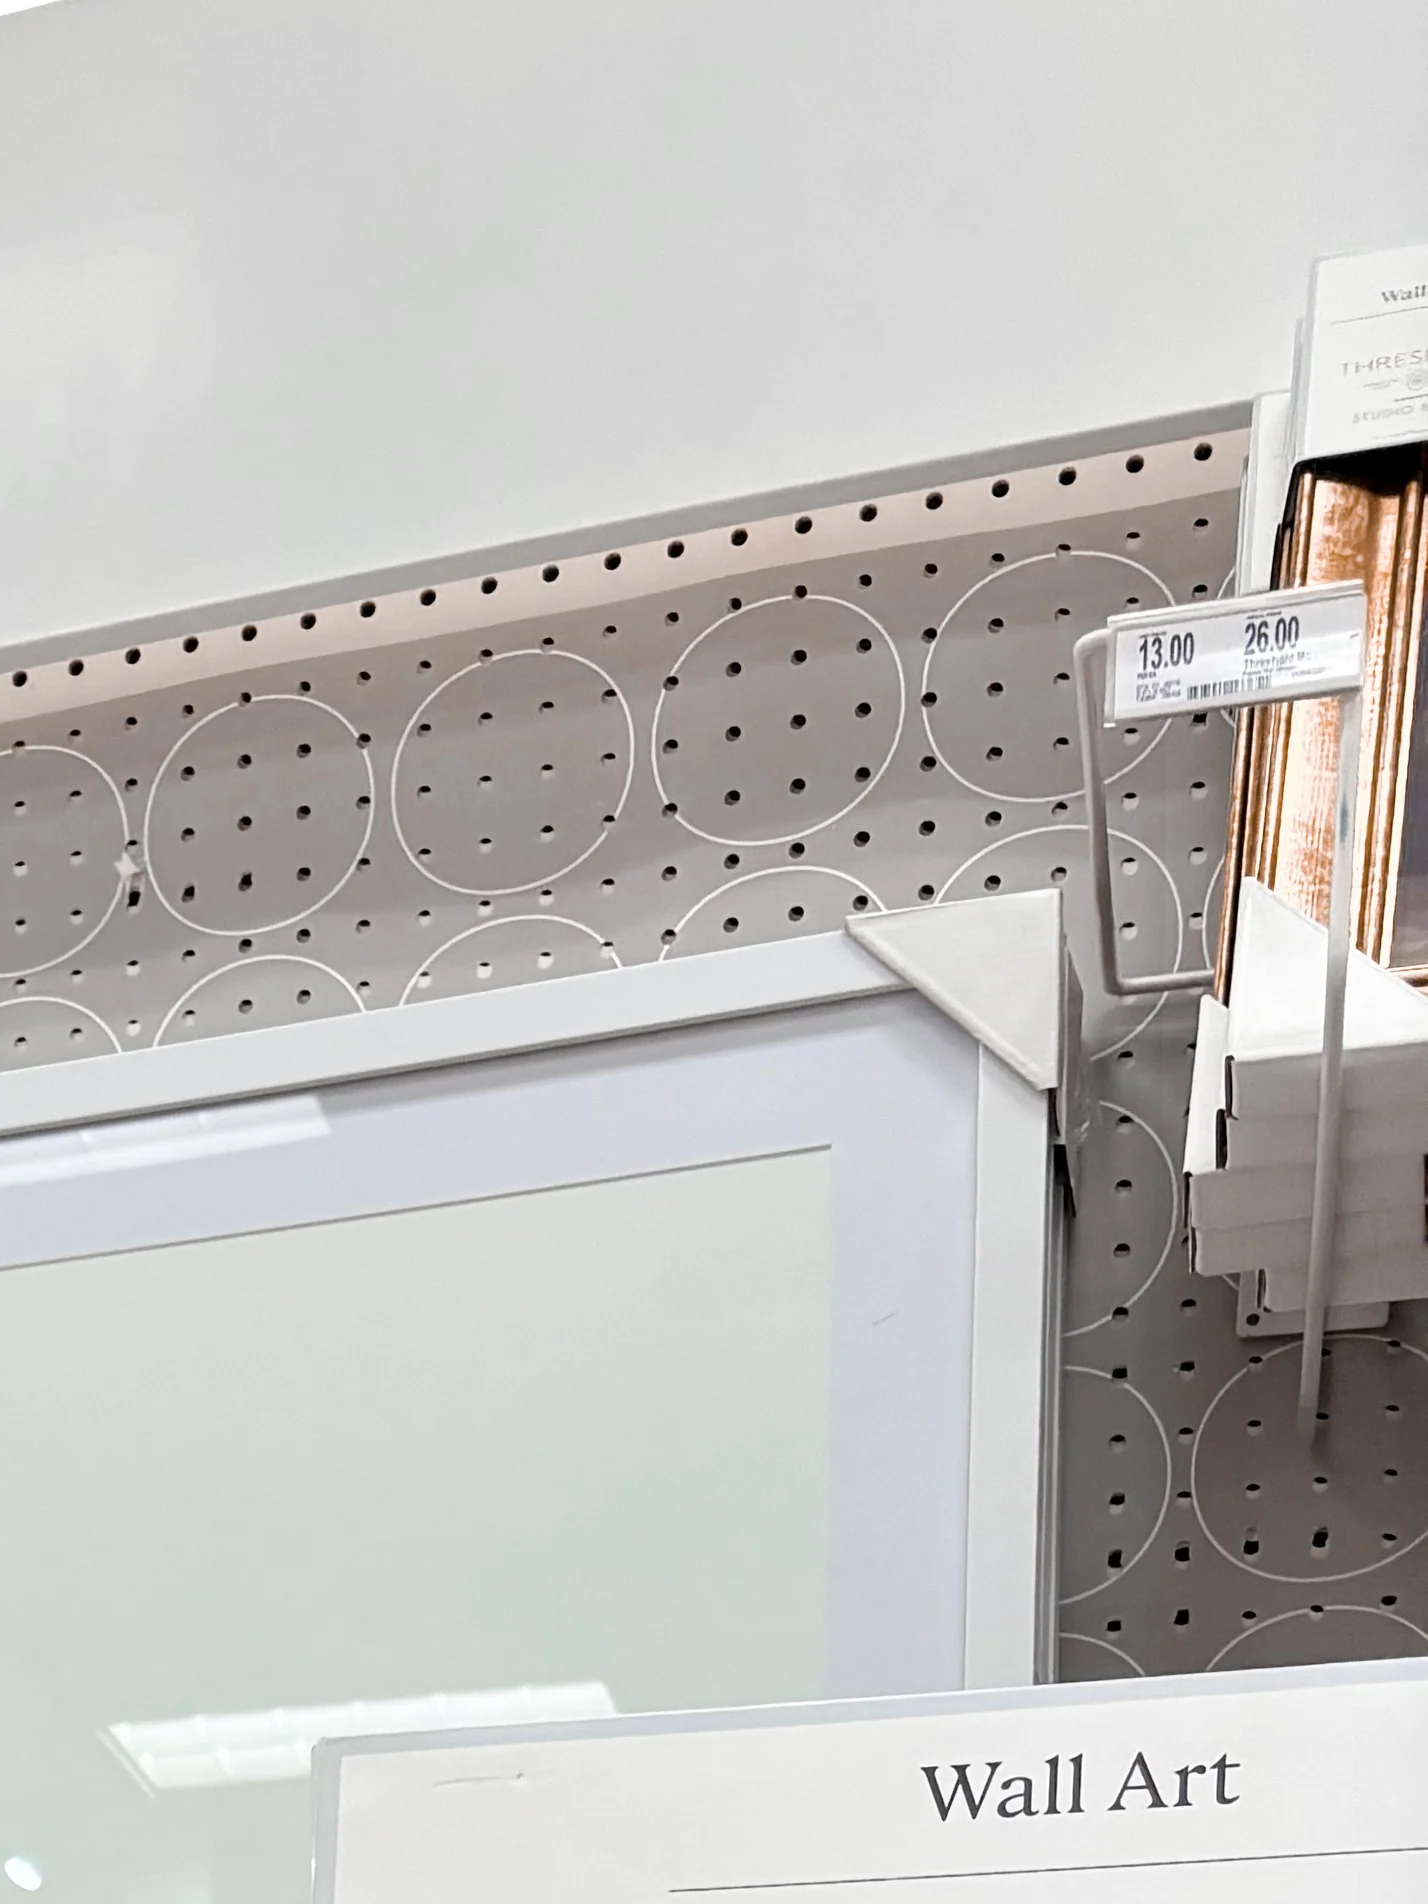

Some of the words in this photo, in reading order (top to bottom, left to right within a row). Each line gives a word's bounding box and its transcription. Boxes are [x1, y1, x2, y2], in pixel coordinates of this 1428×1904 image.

[1381, 284, 1427, 303] Wall
[1341, 350, 1428, 377] THRES
[1139, 632, 1194, 671] 13.00
[1244, 616, 1299, 655] 26.00
[920, 1753, 1085, 1822] Wall
[1107, 1751, 1241, 1812] Art
